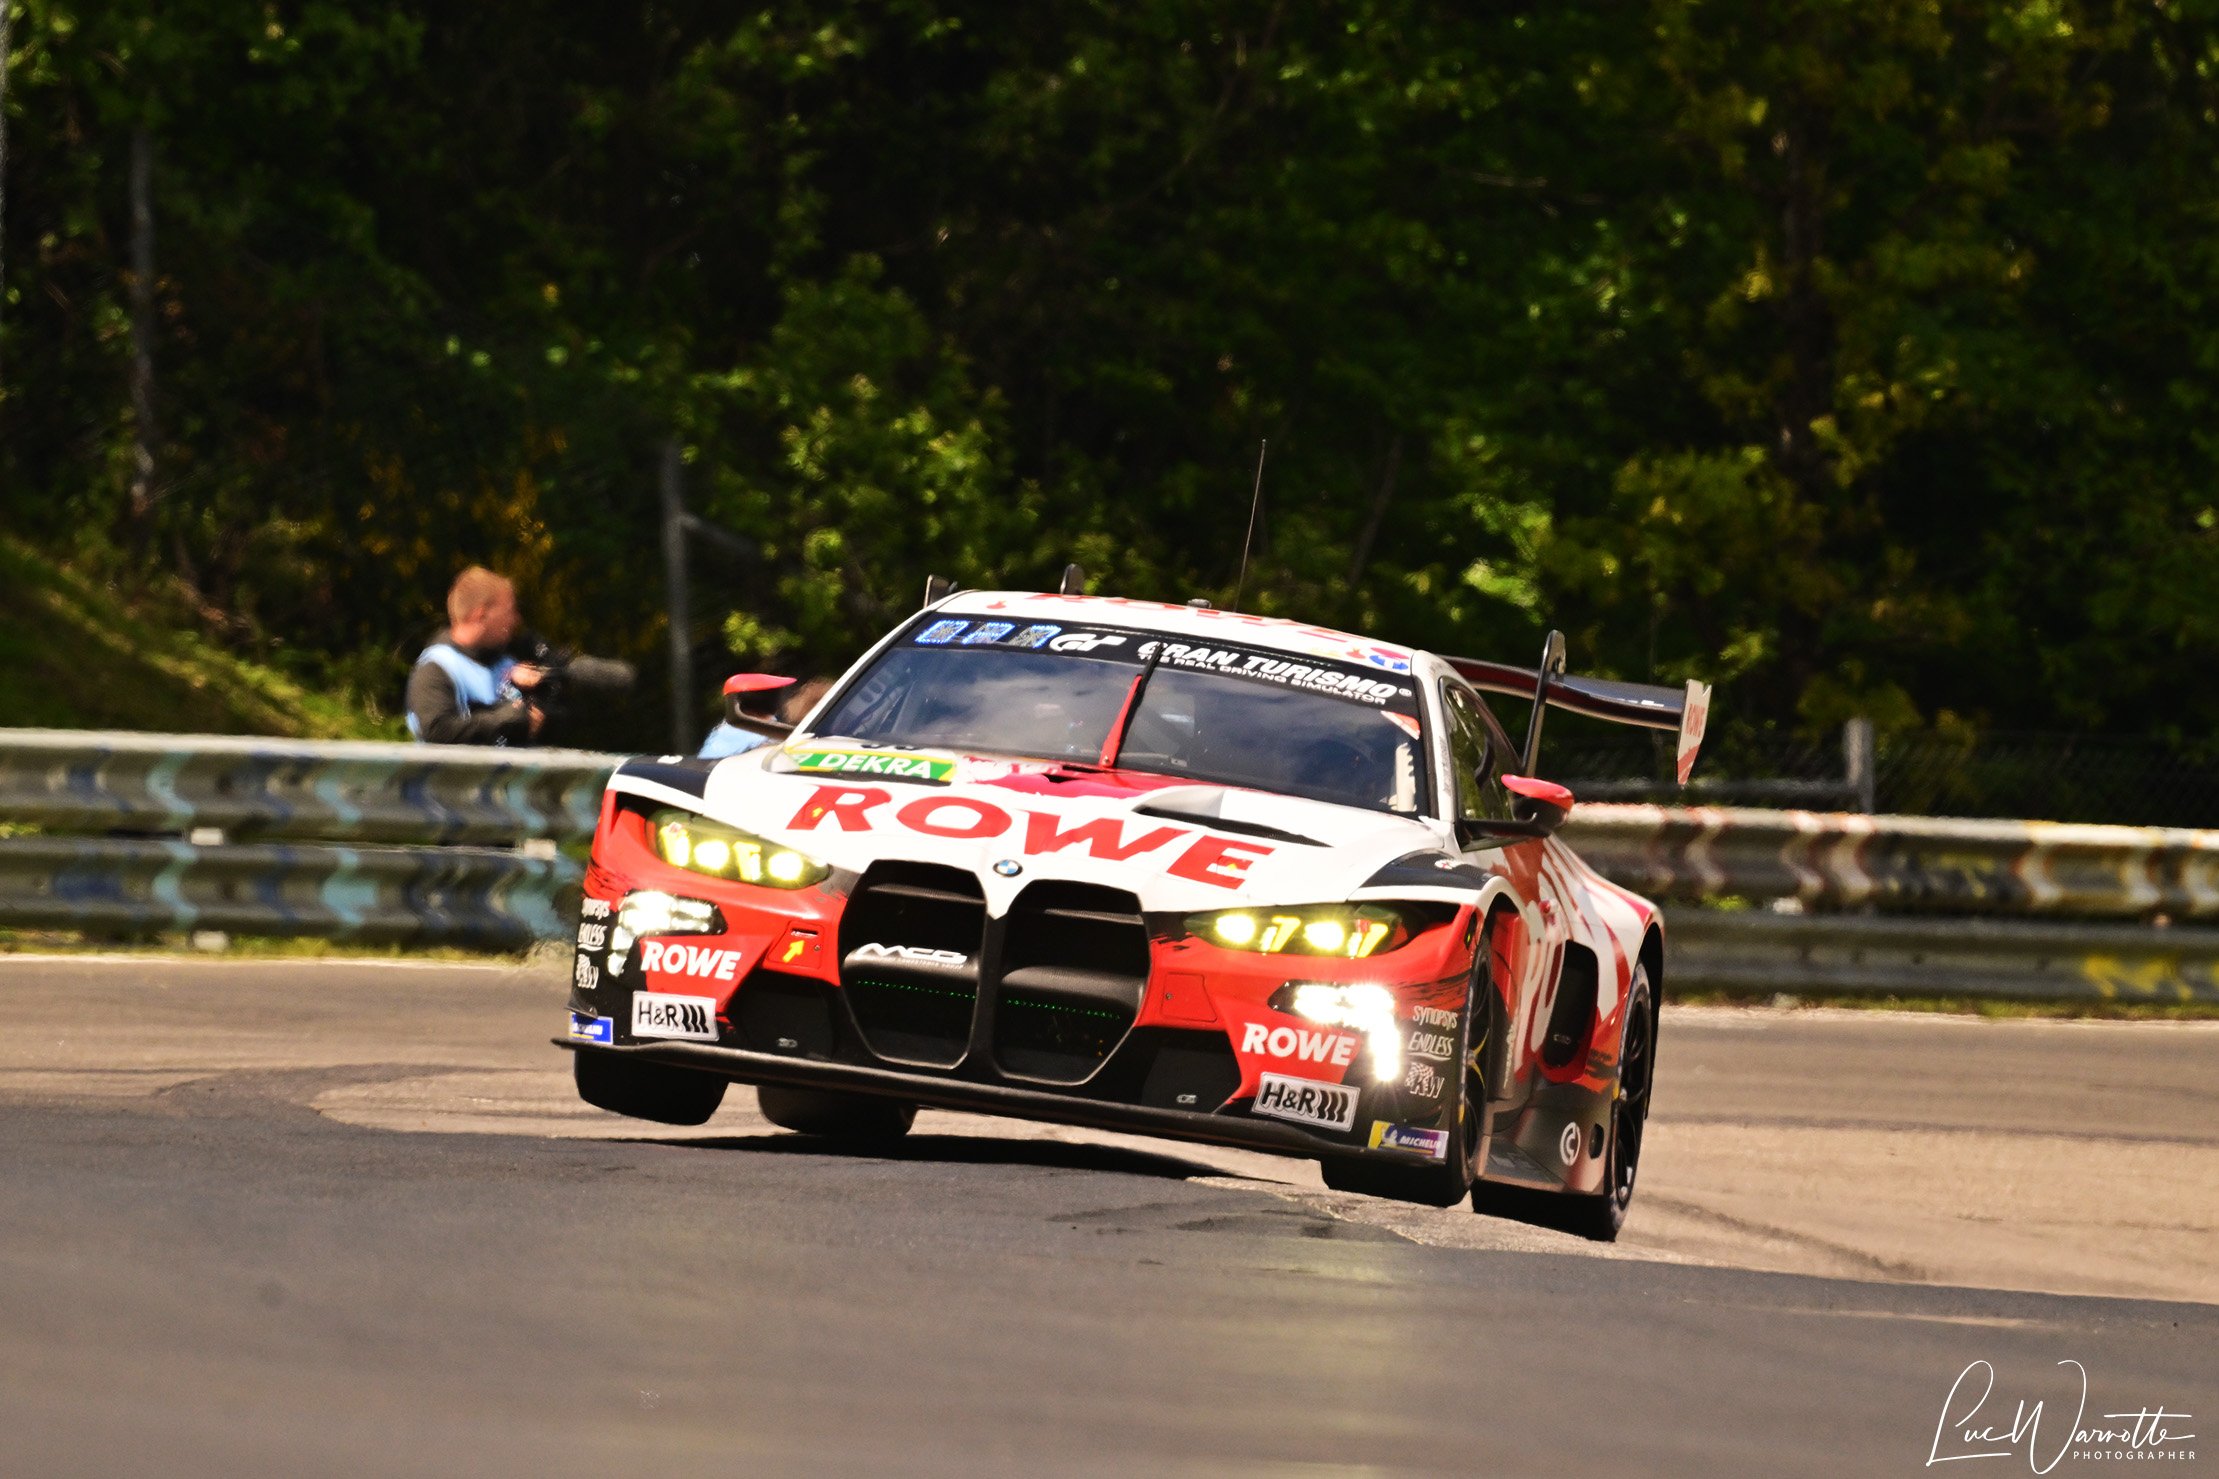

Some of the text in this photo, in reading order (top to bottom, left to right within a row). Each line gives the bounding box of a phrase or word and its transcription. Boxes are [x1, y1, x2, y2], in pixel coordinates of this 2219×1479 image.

[1138, 641, 1240, 665] GRAN
[1174, 658, 1216, 671] REAL
[1219, 665, 1287, 683] DRIVING
[1290, 679, 1386, 705] SIMULATOR
[817, 753, 931, 778] DEKRA
[786, 784, 1276, 890] ROWE
[641, 941, 742, 981] ROWE
[1413, 1005, 1458, 1031] SYNOPSYS
[1241, 1022, 1356, 1066] ROWE
[1408, 1031, 1454, 1057] ENDLESS
